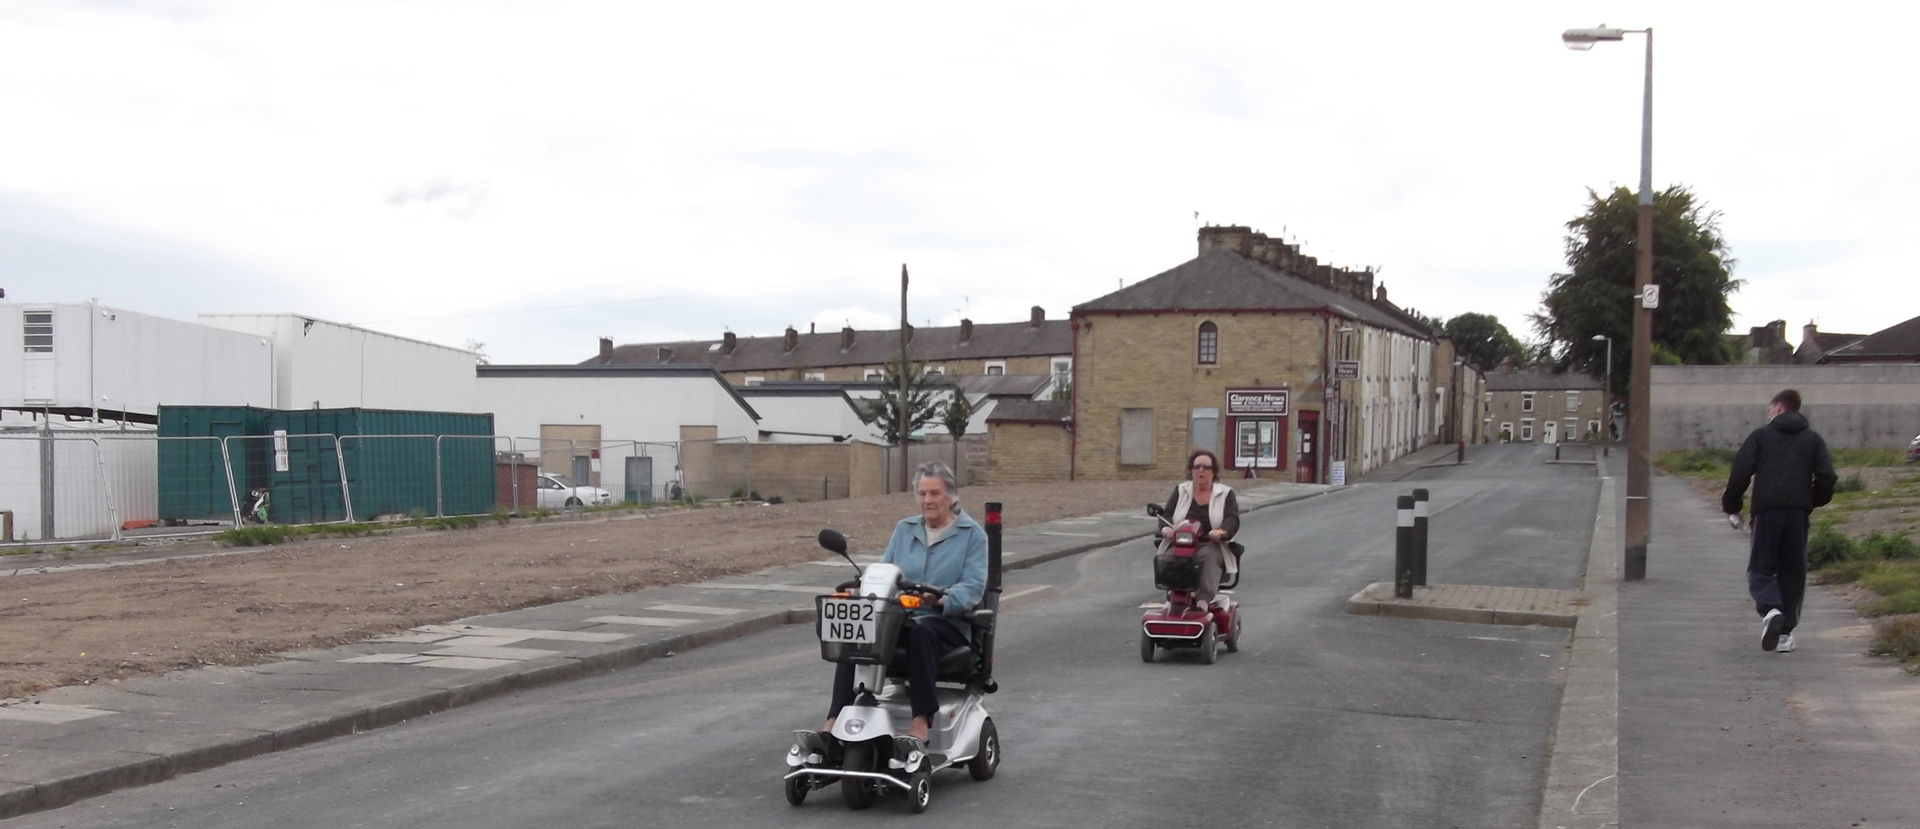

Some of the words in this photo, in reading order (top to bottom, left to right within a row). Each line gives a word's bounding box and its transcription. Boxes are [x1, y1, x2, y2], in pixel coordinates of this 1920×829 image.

[1230, 394, 1262, 402] Clarence
[1263, 394, 1284, 402] News
[824, 602, 874, 621] Q882
[830, 622, 866, 640] NBA
